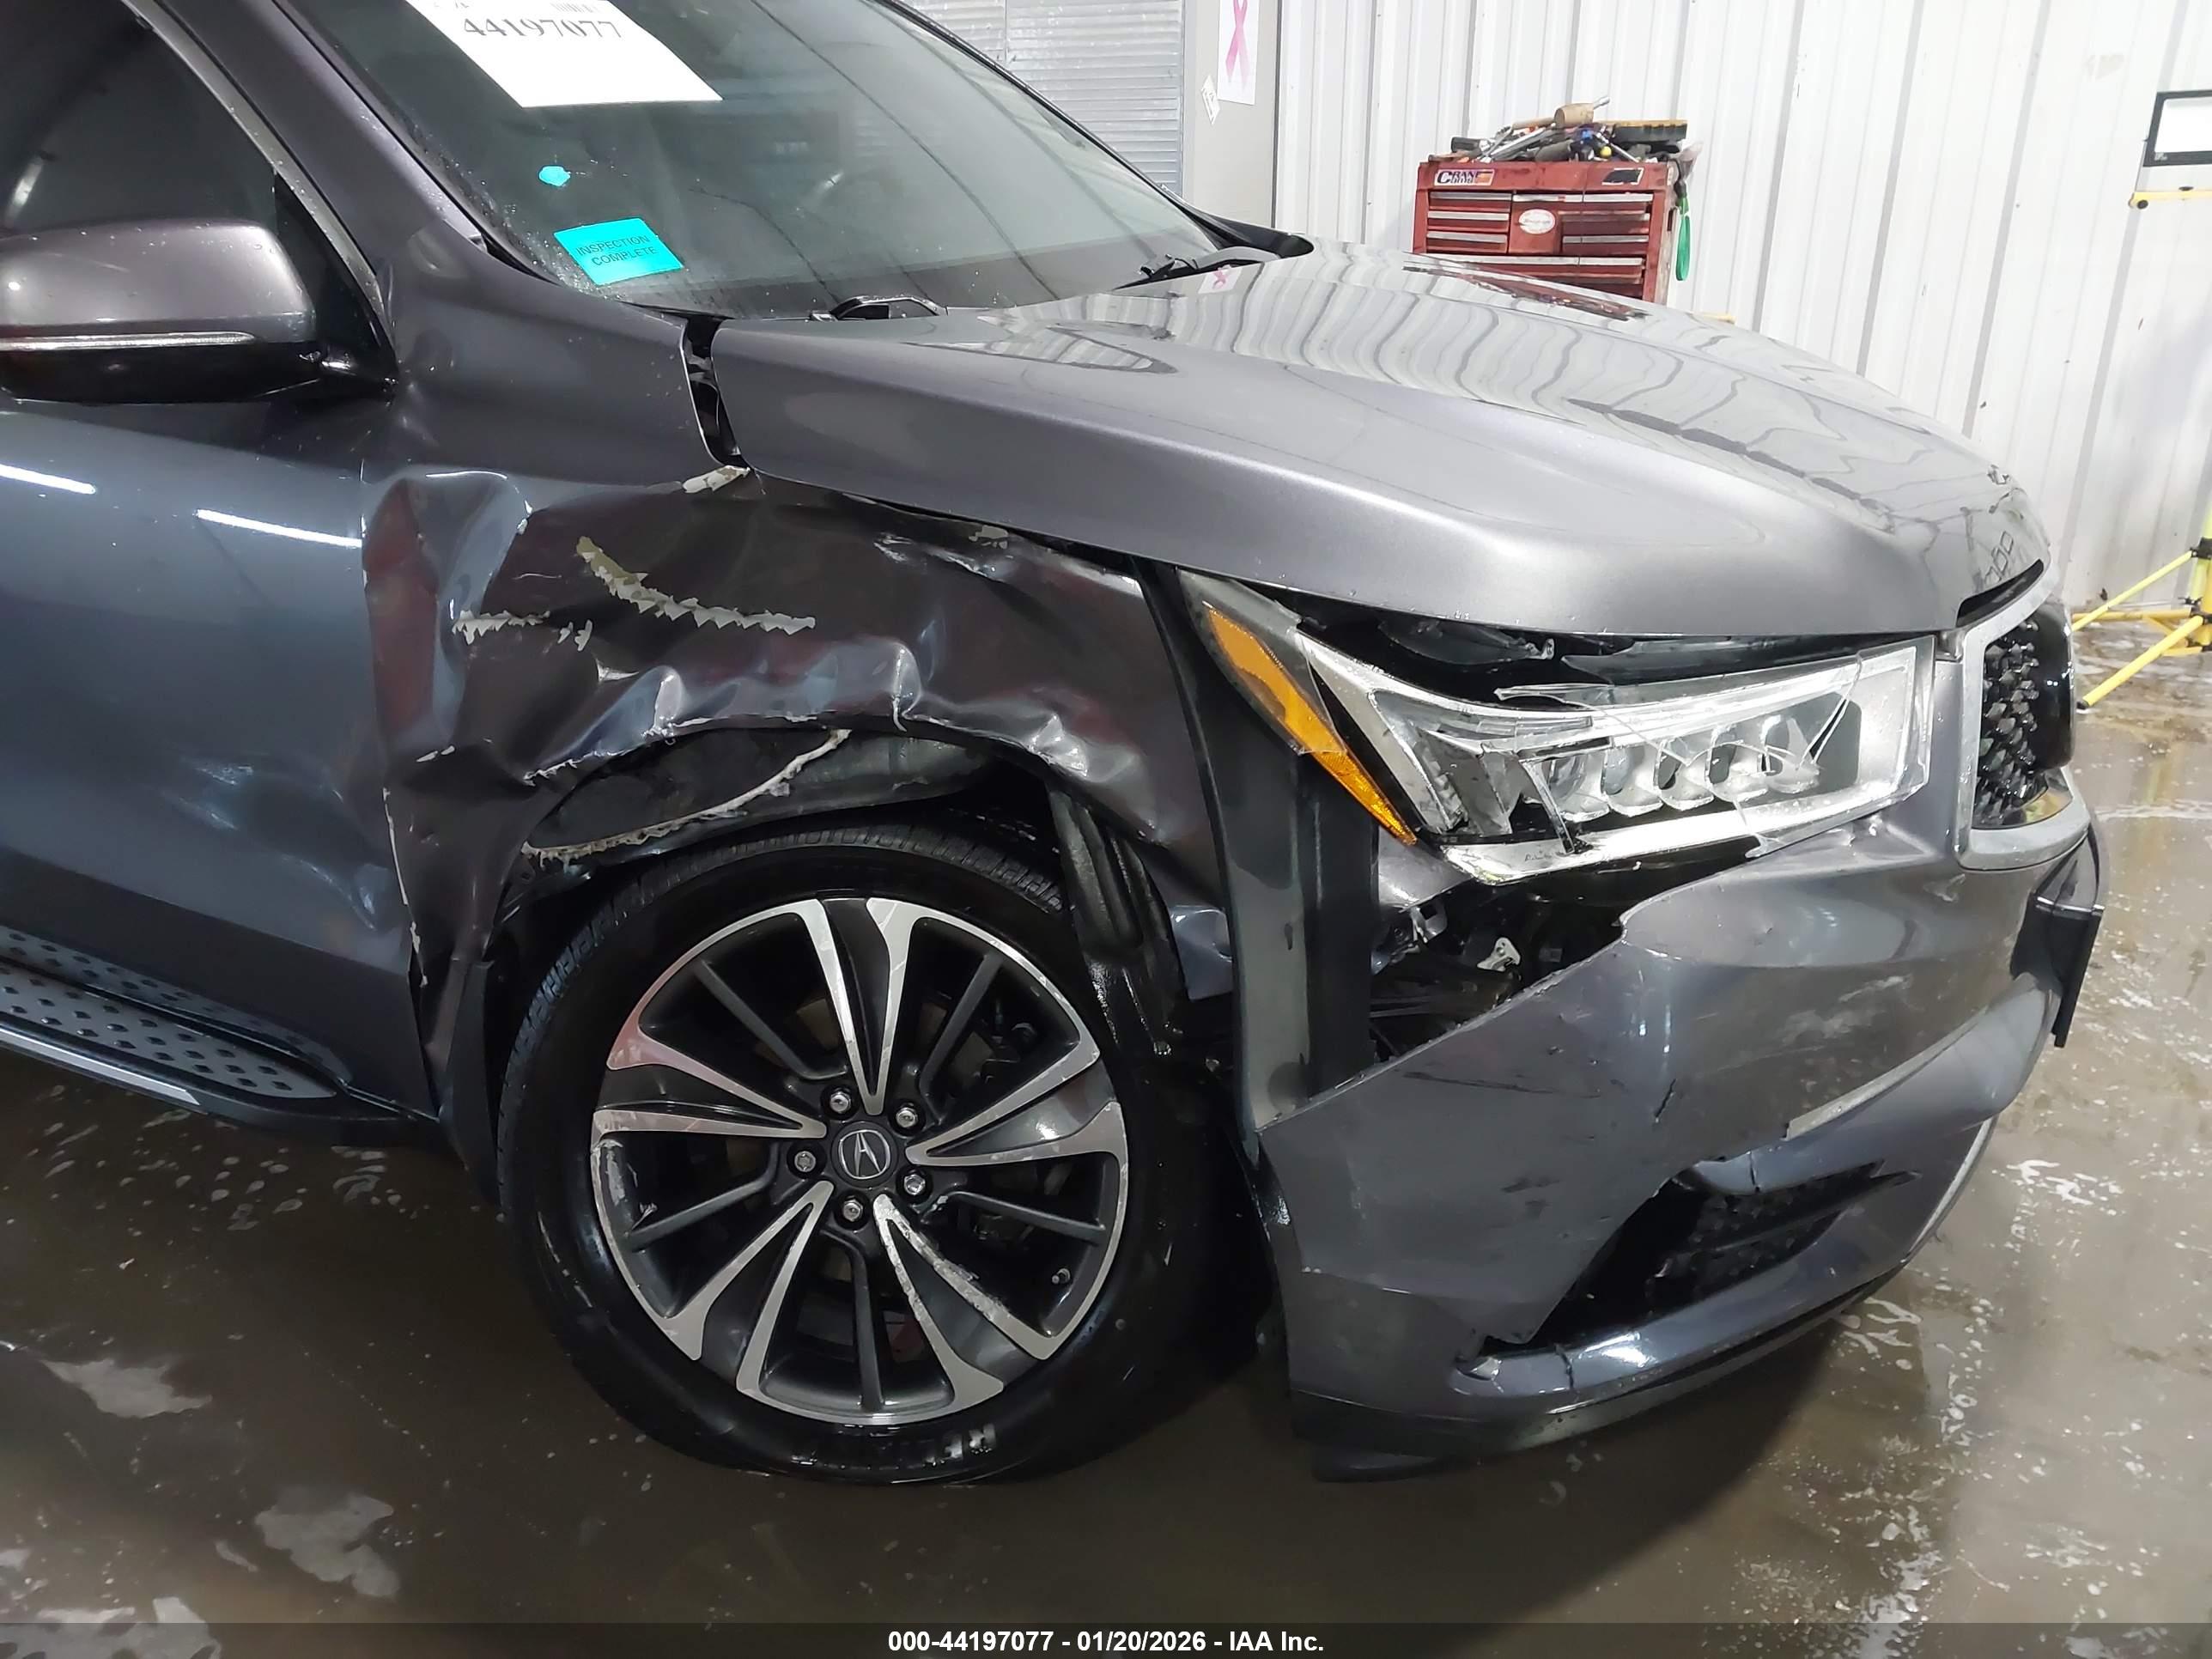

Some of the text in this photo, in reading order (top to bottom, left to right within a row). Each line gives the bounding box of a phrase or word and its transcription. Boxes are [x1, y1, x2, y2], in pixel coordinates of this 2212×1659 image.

[464, 18, 623, 38] 44197077
[575, 234, 651, 256] INSPECTION
[591, 246, 658, 266] COMPLETE
